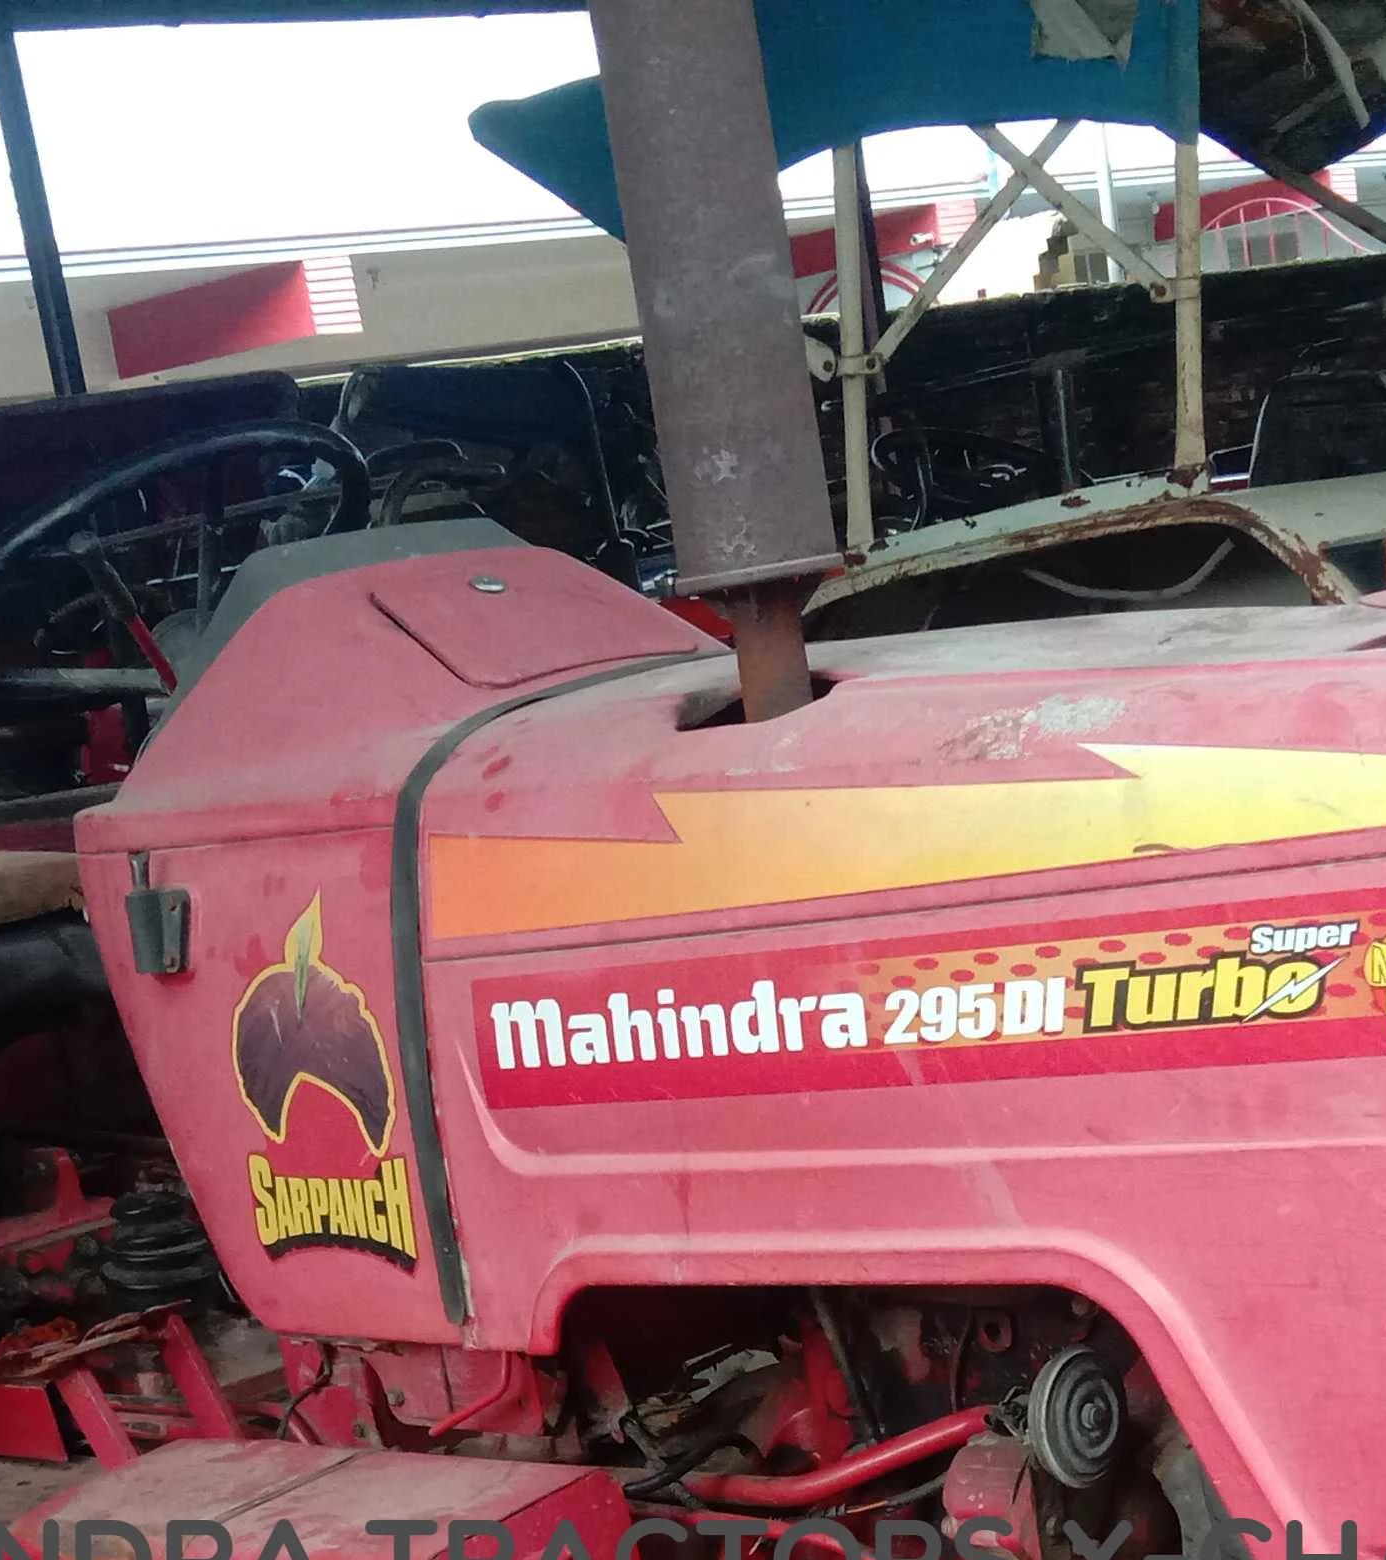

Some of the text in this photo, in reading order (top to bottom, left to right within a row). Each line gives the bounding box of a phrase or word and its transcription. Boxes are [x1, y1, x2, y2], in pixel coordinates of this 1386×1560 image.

[1252, 921, 1359, 954] Super
[490, 980, 868, 1070] Mahindra
[1079, 955, 1323, 1030] Turbo
[248, 1153, 417, 1263] SARPANCH
